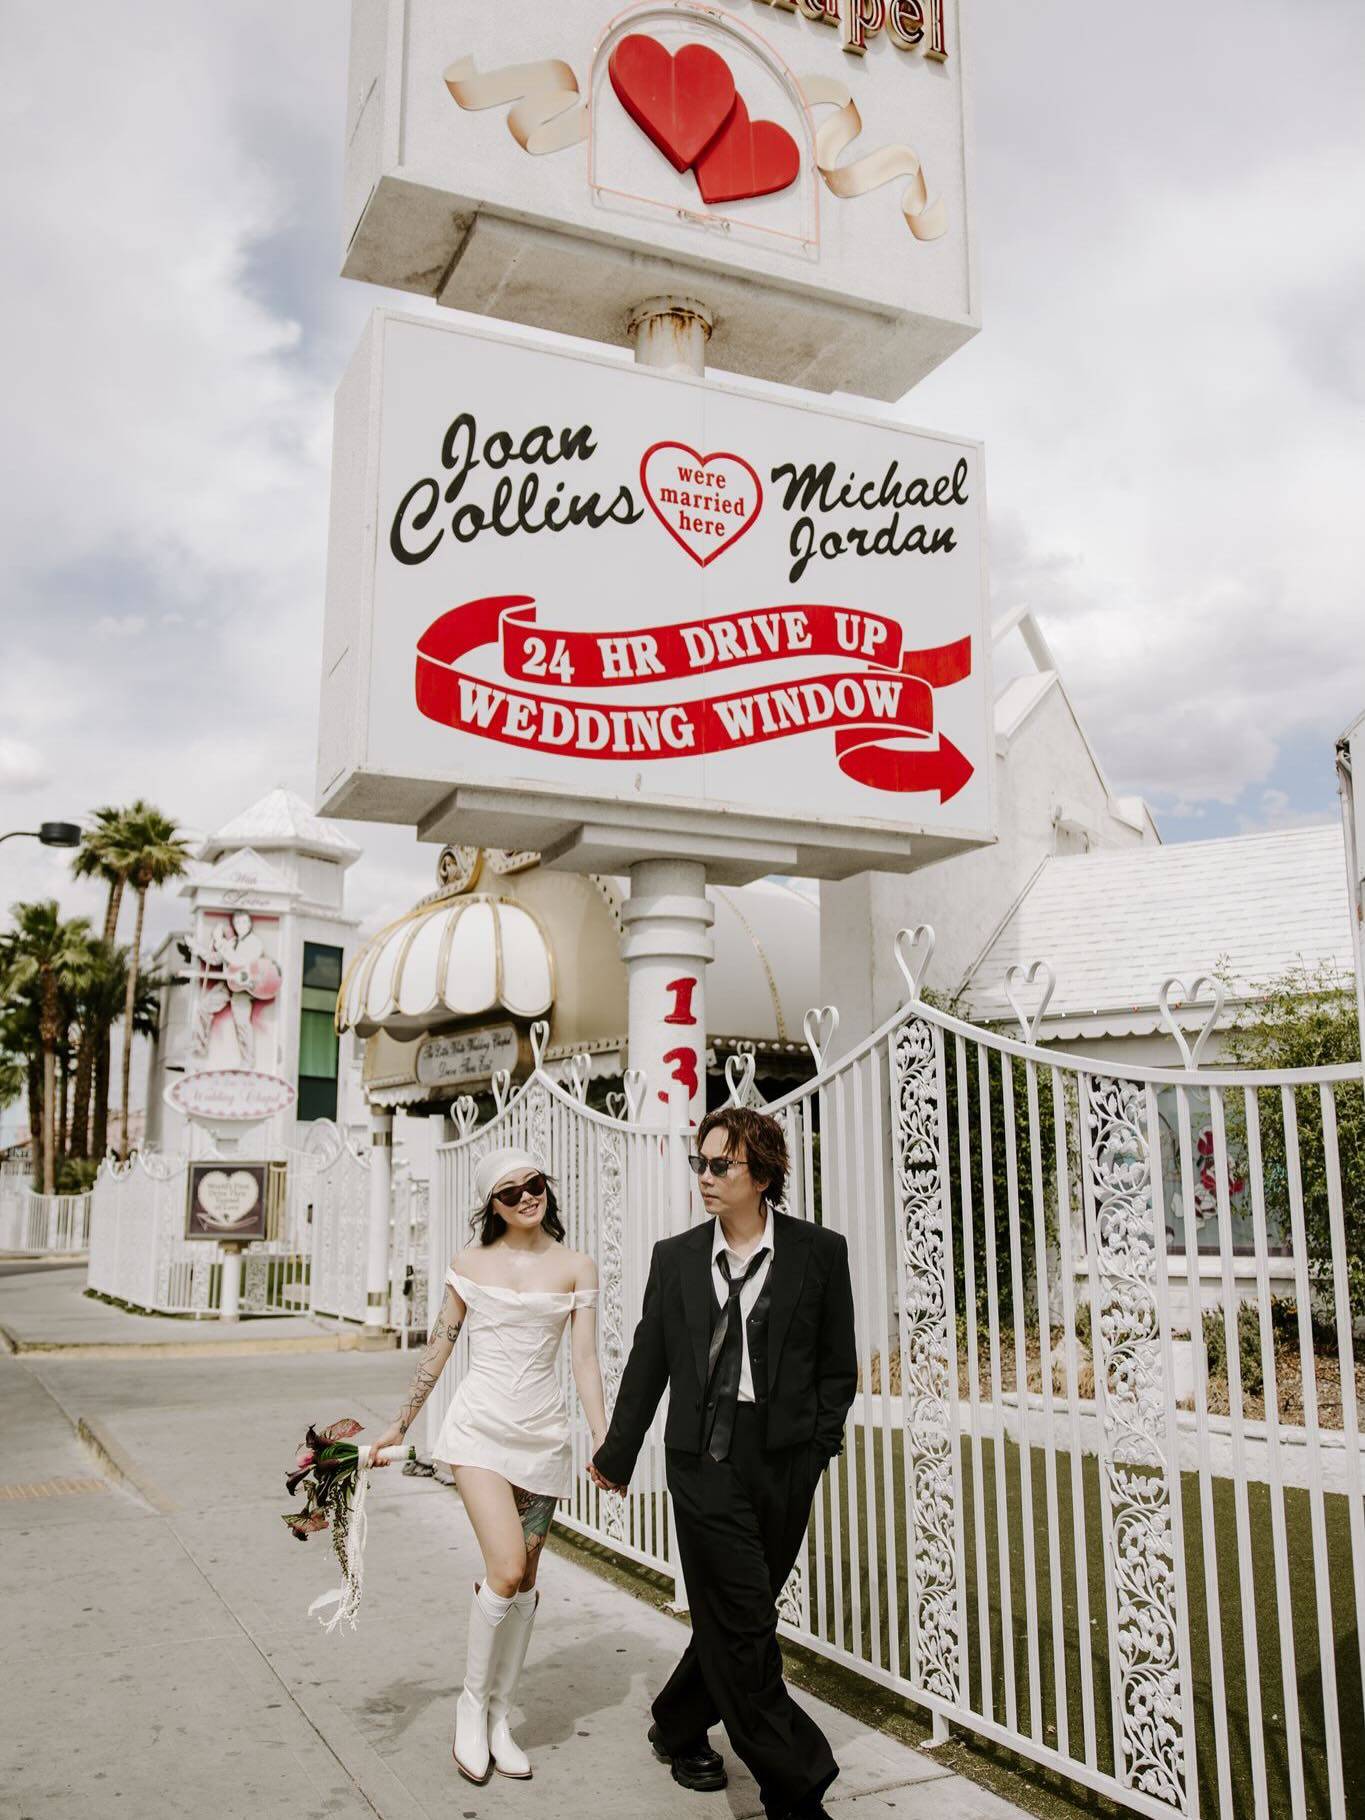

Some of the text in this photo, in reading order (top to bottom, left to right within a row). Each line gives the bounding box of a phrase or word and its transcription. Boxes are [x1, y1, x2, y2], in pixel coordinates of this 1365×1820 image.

[442, 413, 598, 504] Joan
[678, 465, 726, 489] were
[771, 458, 969, 513] Michael
[390, 472, 645, 566] Collins
[660, 488, 746, 518] married
[679, 511, 725, 538] here
[789, 512, 958, 584] Jordan
[522, 611, 888, 684] 24 HR DRIVE UP
[458, 678, 903, 752] WEDDING WINDOW
